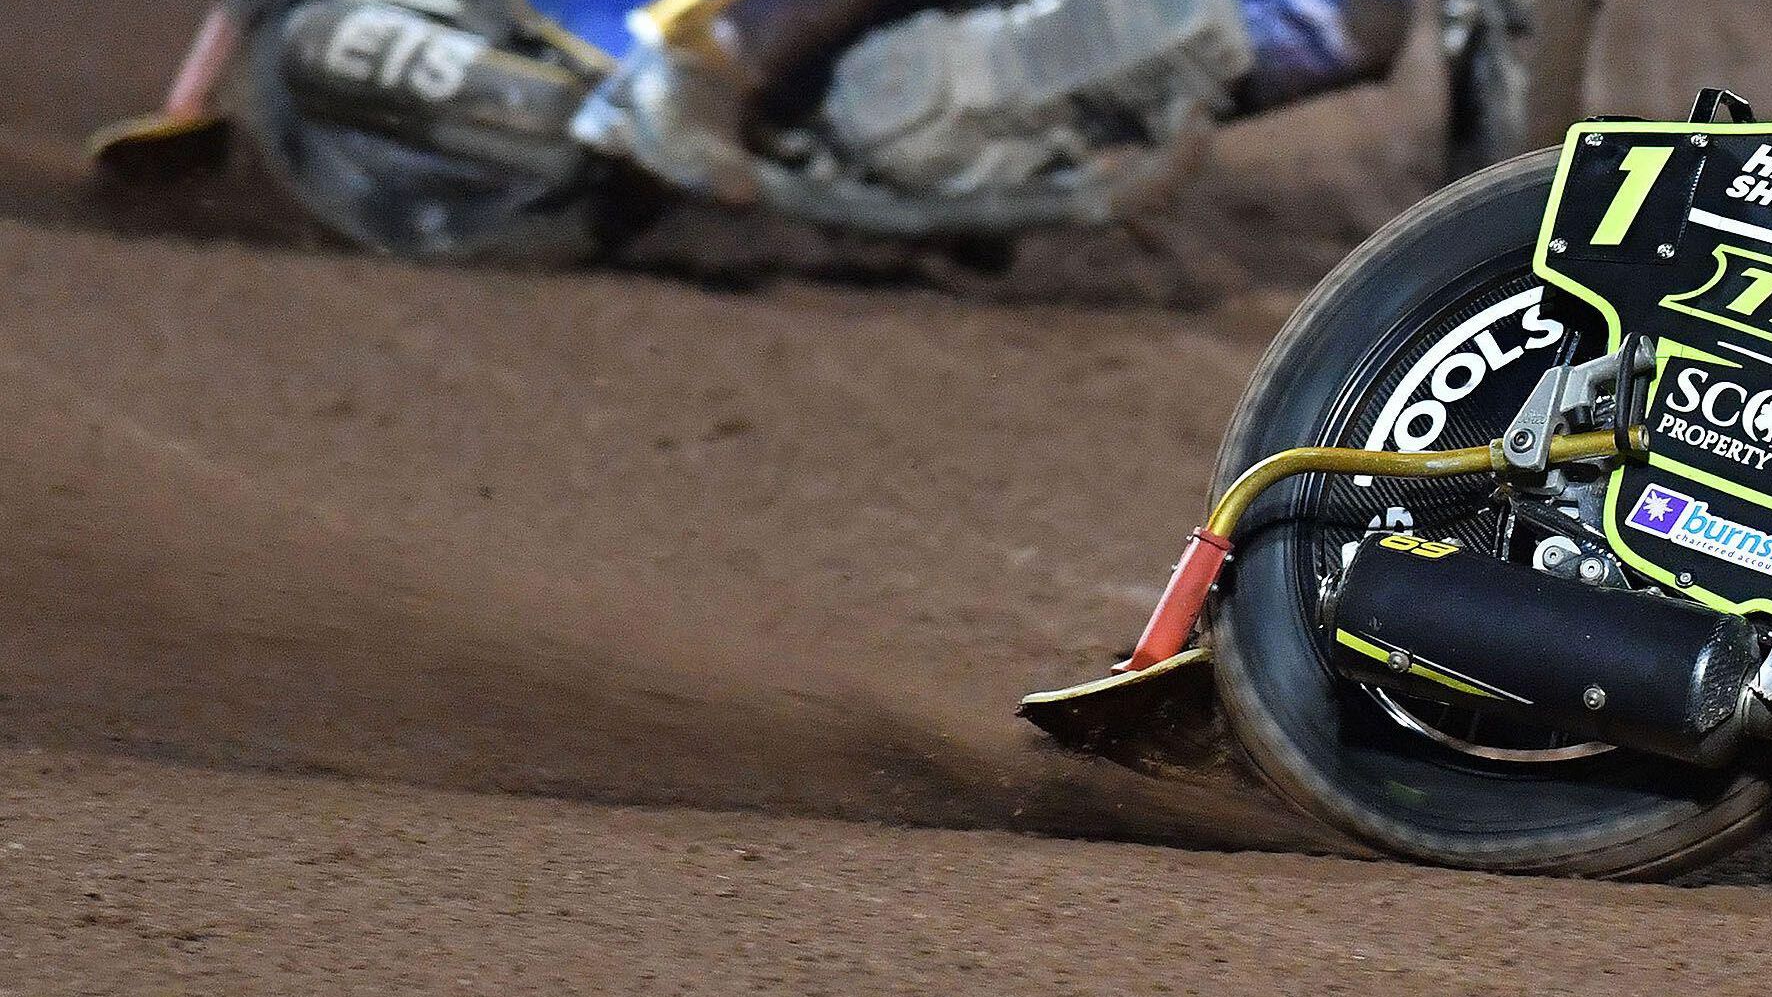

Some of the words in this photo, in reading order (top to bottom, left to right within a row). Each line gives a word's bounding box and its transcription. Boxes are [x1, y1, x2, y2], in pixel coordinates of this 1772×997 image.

[1589, 146, 1675, 245] 1
[1393, 304, 1565, 453] OOLS
[1675, 533, 1735, 559] chartered
